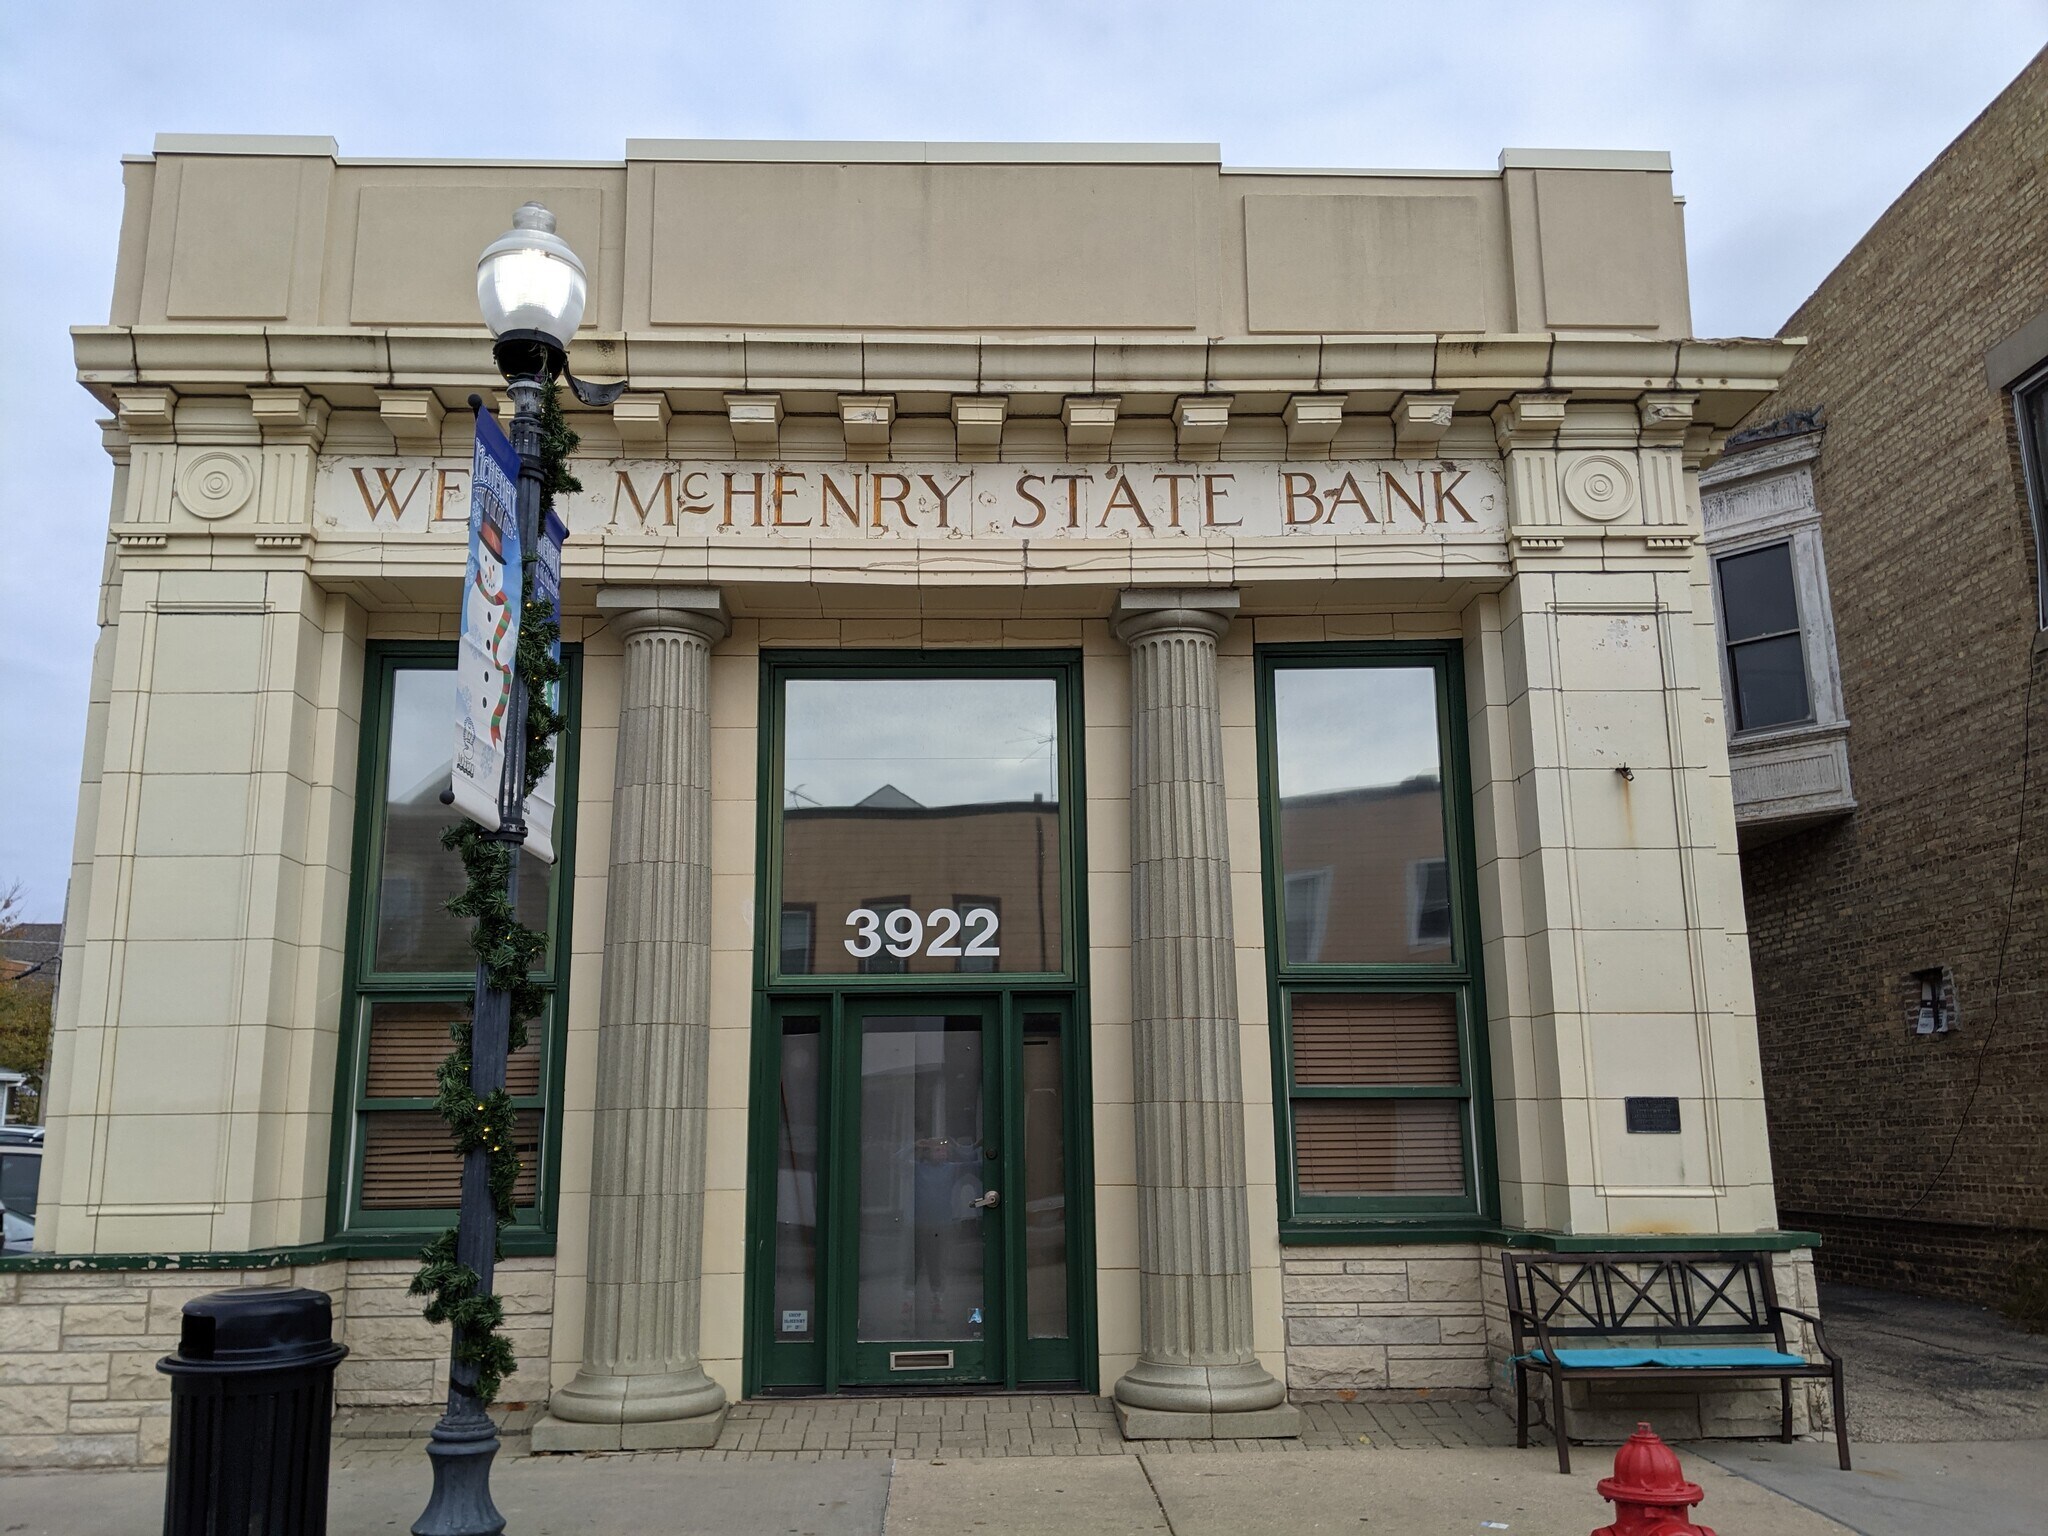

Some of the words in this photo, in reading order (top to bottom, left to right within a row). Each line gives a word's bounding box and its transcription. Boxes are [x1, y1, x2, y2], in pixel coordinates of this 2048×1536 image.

[349, 466, 470, 522] WE
[1012, 473, 1244, 528] STATE
[1280, 470, 1478, 525] BANK
[844, 908, 1000, 958] 3922
